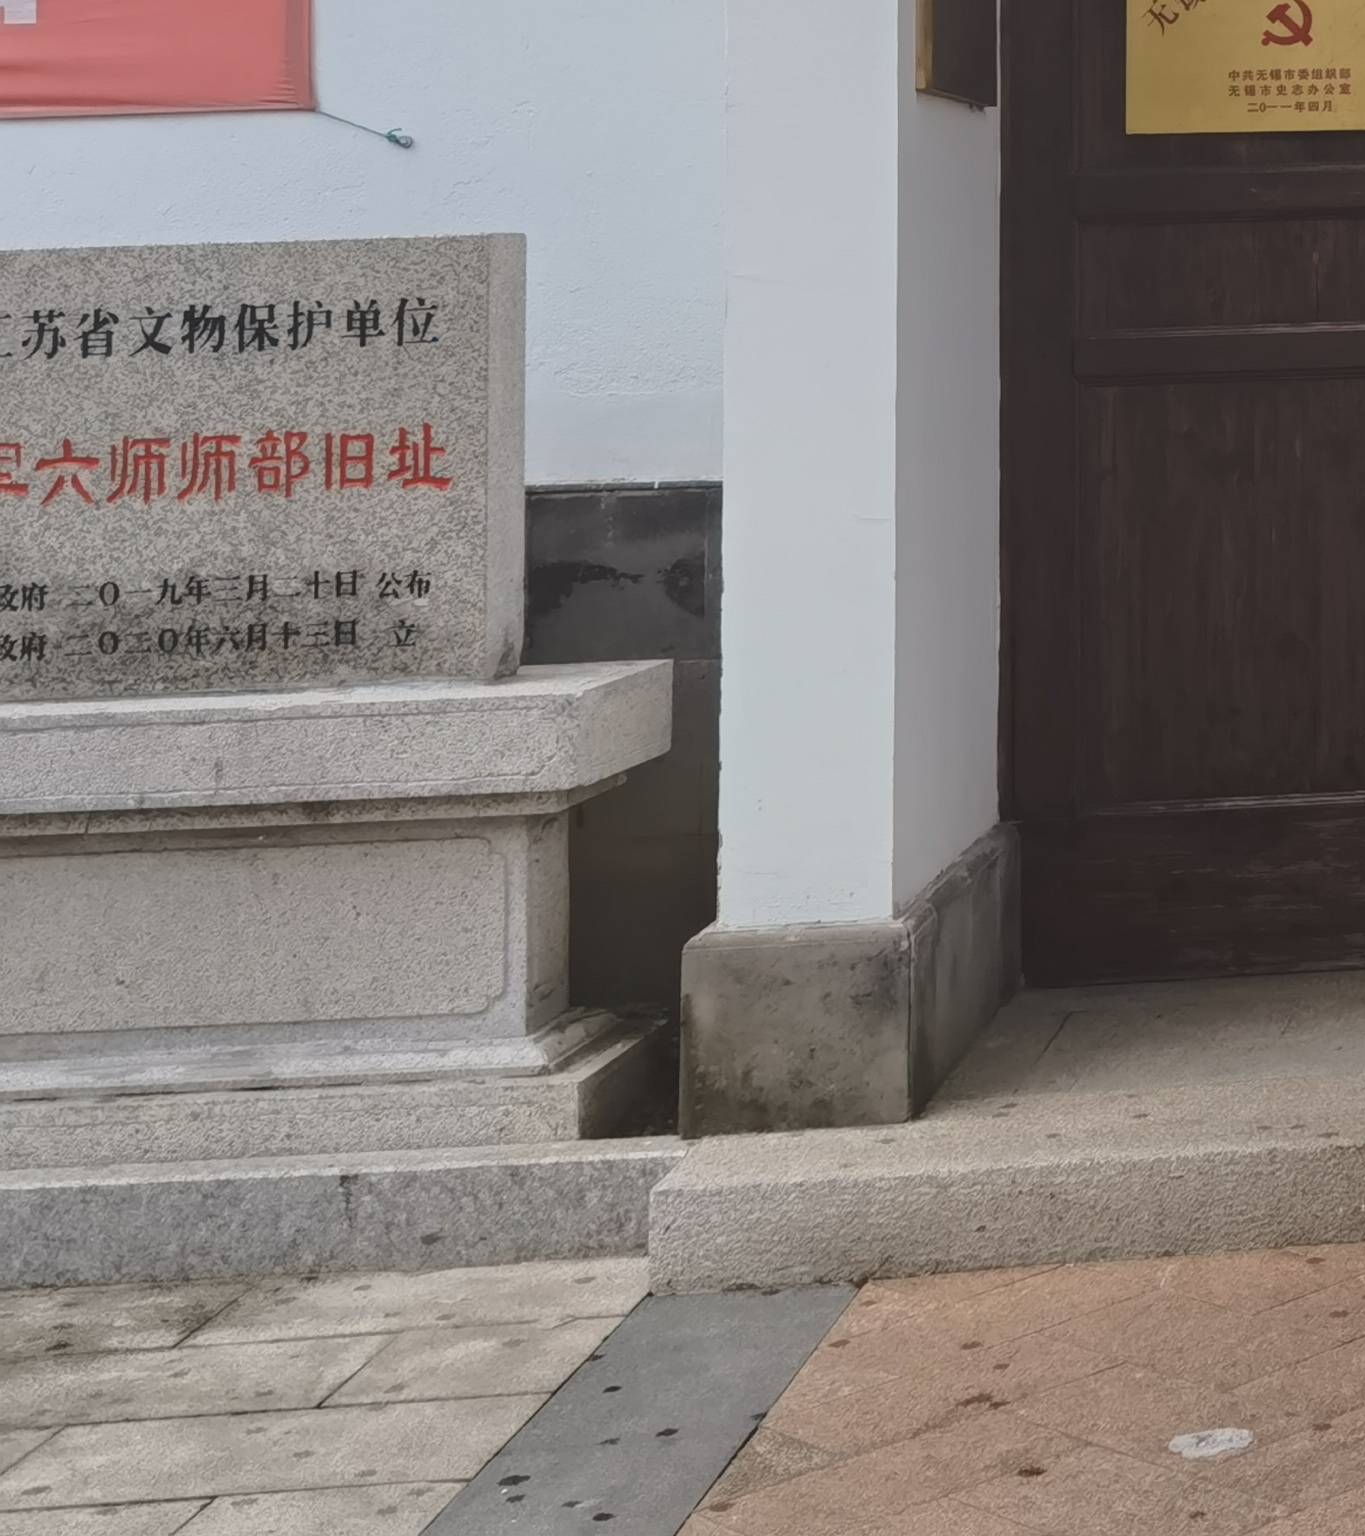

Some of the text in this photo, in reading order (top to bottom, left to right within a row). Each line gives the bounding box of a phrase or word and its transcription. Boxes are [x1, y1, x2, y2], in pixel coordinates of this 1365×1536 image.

[1228, 68, 1352, 81] 中共无锡市委组织部
[375, 569, 432, 600] 公布
[389, 618, 417, 648] 立
